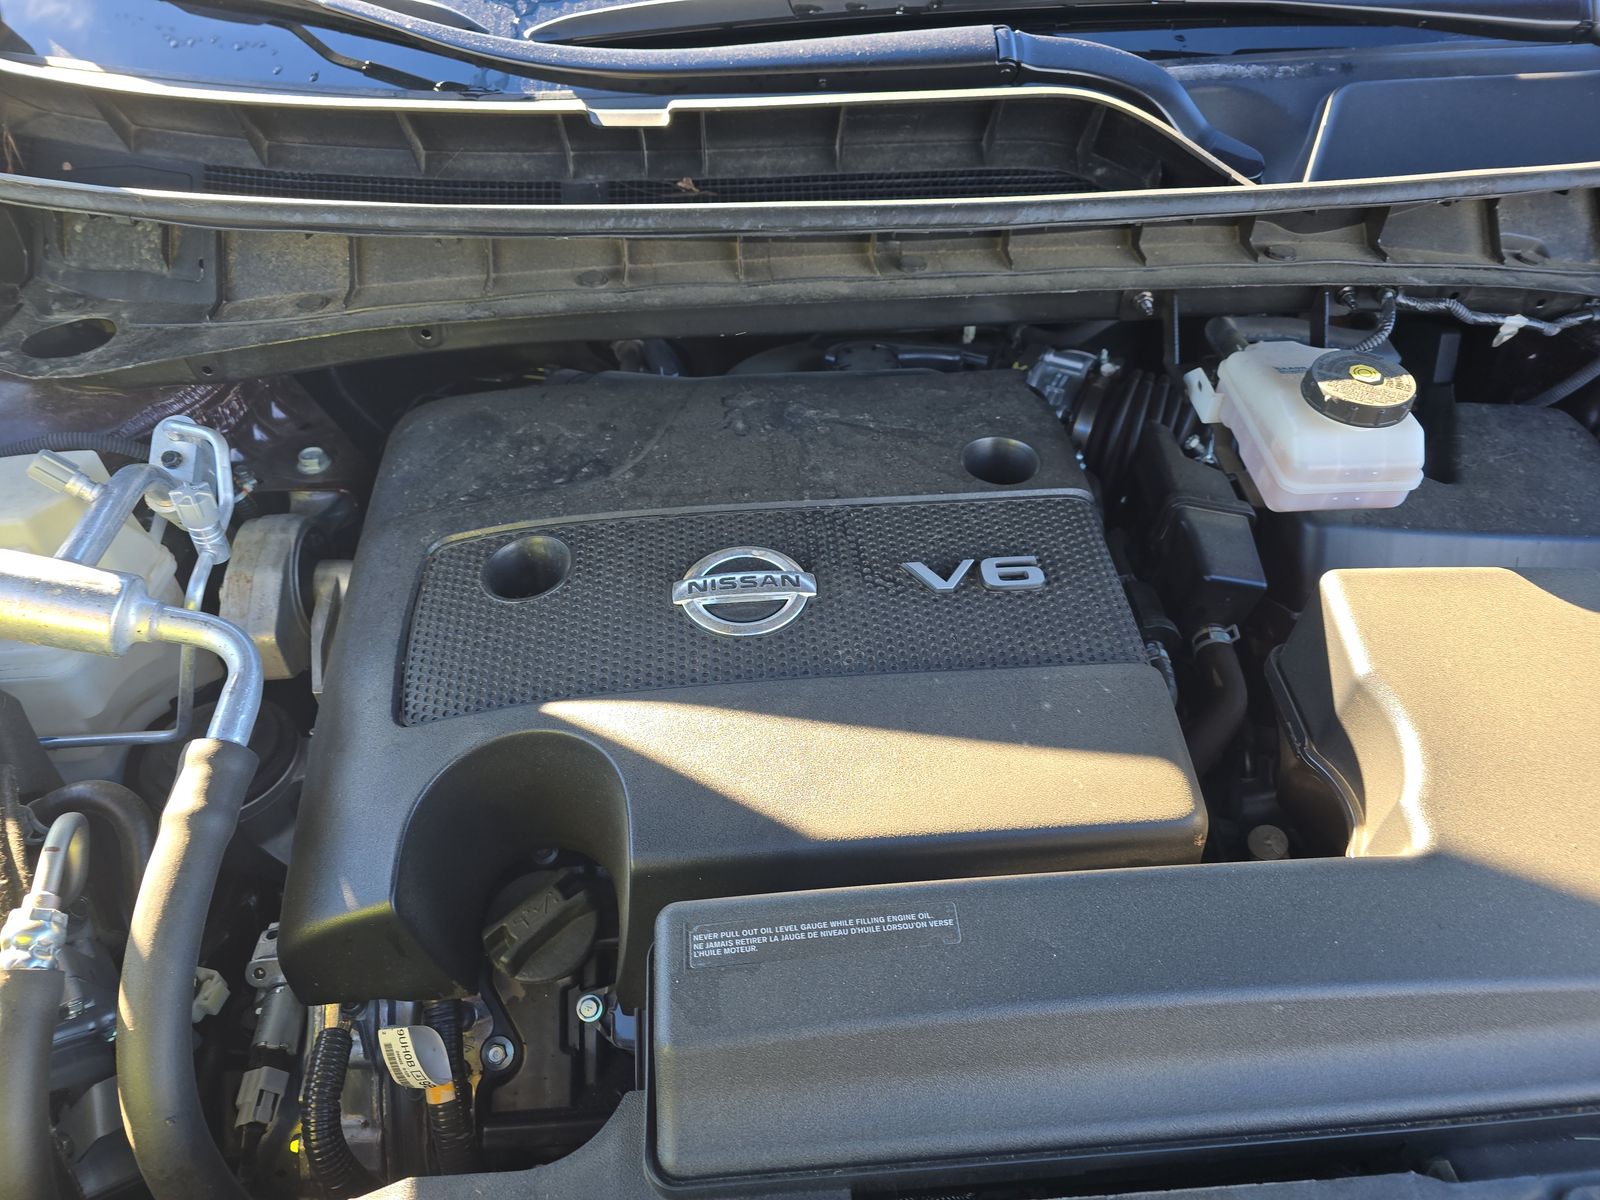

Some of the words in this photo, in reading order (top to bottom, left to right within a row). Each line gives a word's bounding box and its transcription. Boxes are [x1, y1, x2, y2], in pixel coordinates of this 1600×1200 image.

[688, 574, 800, 594] NISSAN
[901, 556, 1046, 593] V6
[693, 932, 718, 941] NEVER
[800, 922, 828, 930] GAUGE
[830, 919, 854, 927] WHILE
[856, 917, 885, 925] FILLING
[887, 914, 916, 922] ENGINE
[706, 940, 734, 948] JAMAIS
[736, 937, 767, 946] RETIRER
[781, 933, 806, 941] JAUGE
[820, 929, 848, 937] NIVEAU
[850, 926, 881, 934] D'HUILE
[882, 922, 927, 932] LORSQU'ON
[928, 919, 954, 927] VERSE
[693, 949, 722, 958] L'HUILE
[724, 945, 758, 954] MOTEUR.
